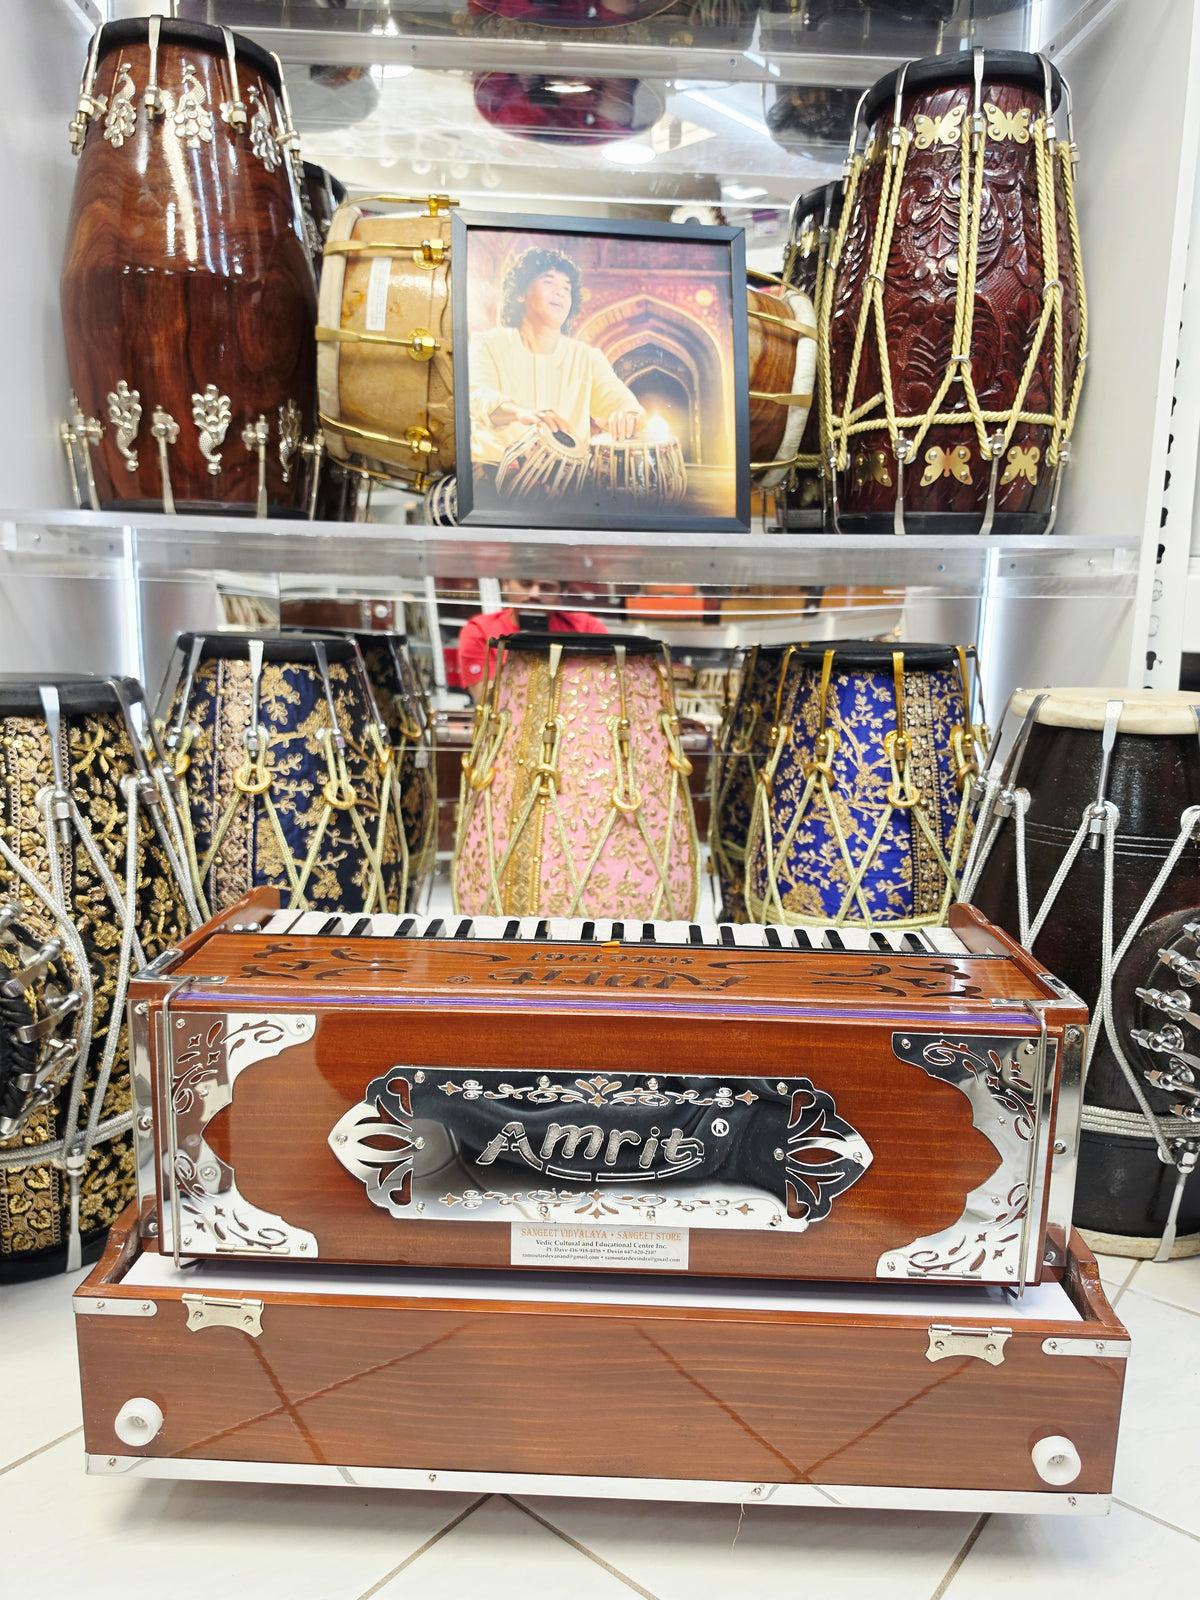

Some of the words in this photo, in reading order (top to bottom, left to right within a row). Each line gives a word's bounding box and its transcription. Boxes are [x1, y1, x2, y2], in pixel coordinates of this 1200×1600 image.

[527, 951, 603, 963] 1961
[475, 1121, 705, 1171] Amrit
[521, 1228, 558, 1238] SANGEET
[560, 1229, 607, 1239] VIDYALAYA
[617, 1231, 655, 1240] SANGEET
[656, 1232, 682, 1241] STORE
